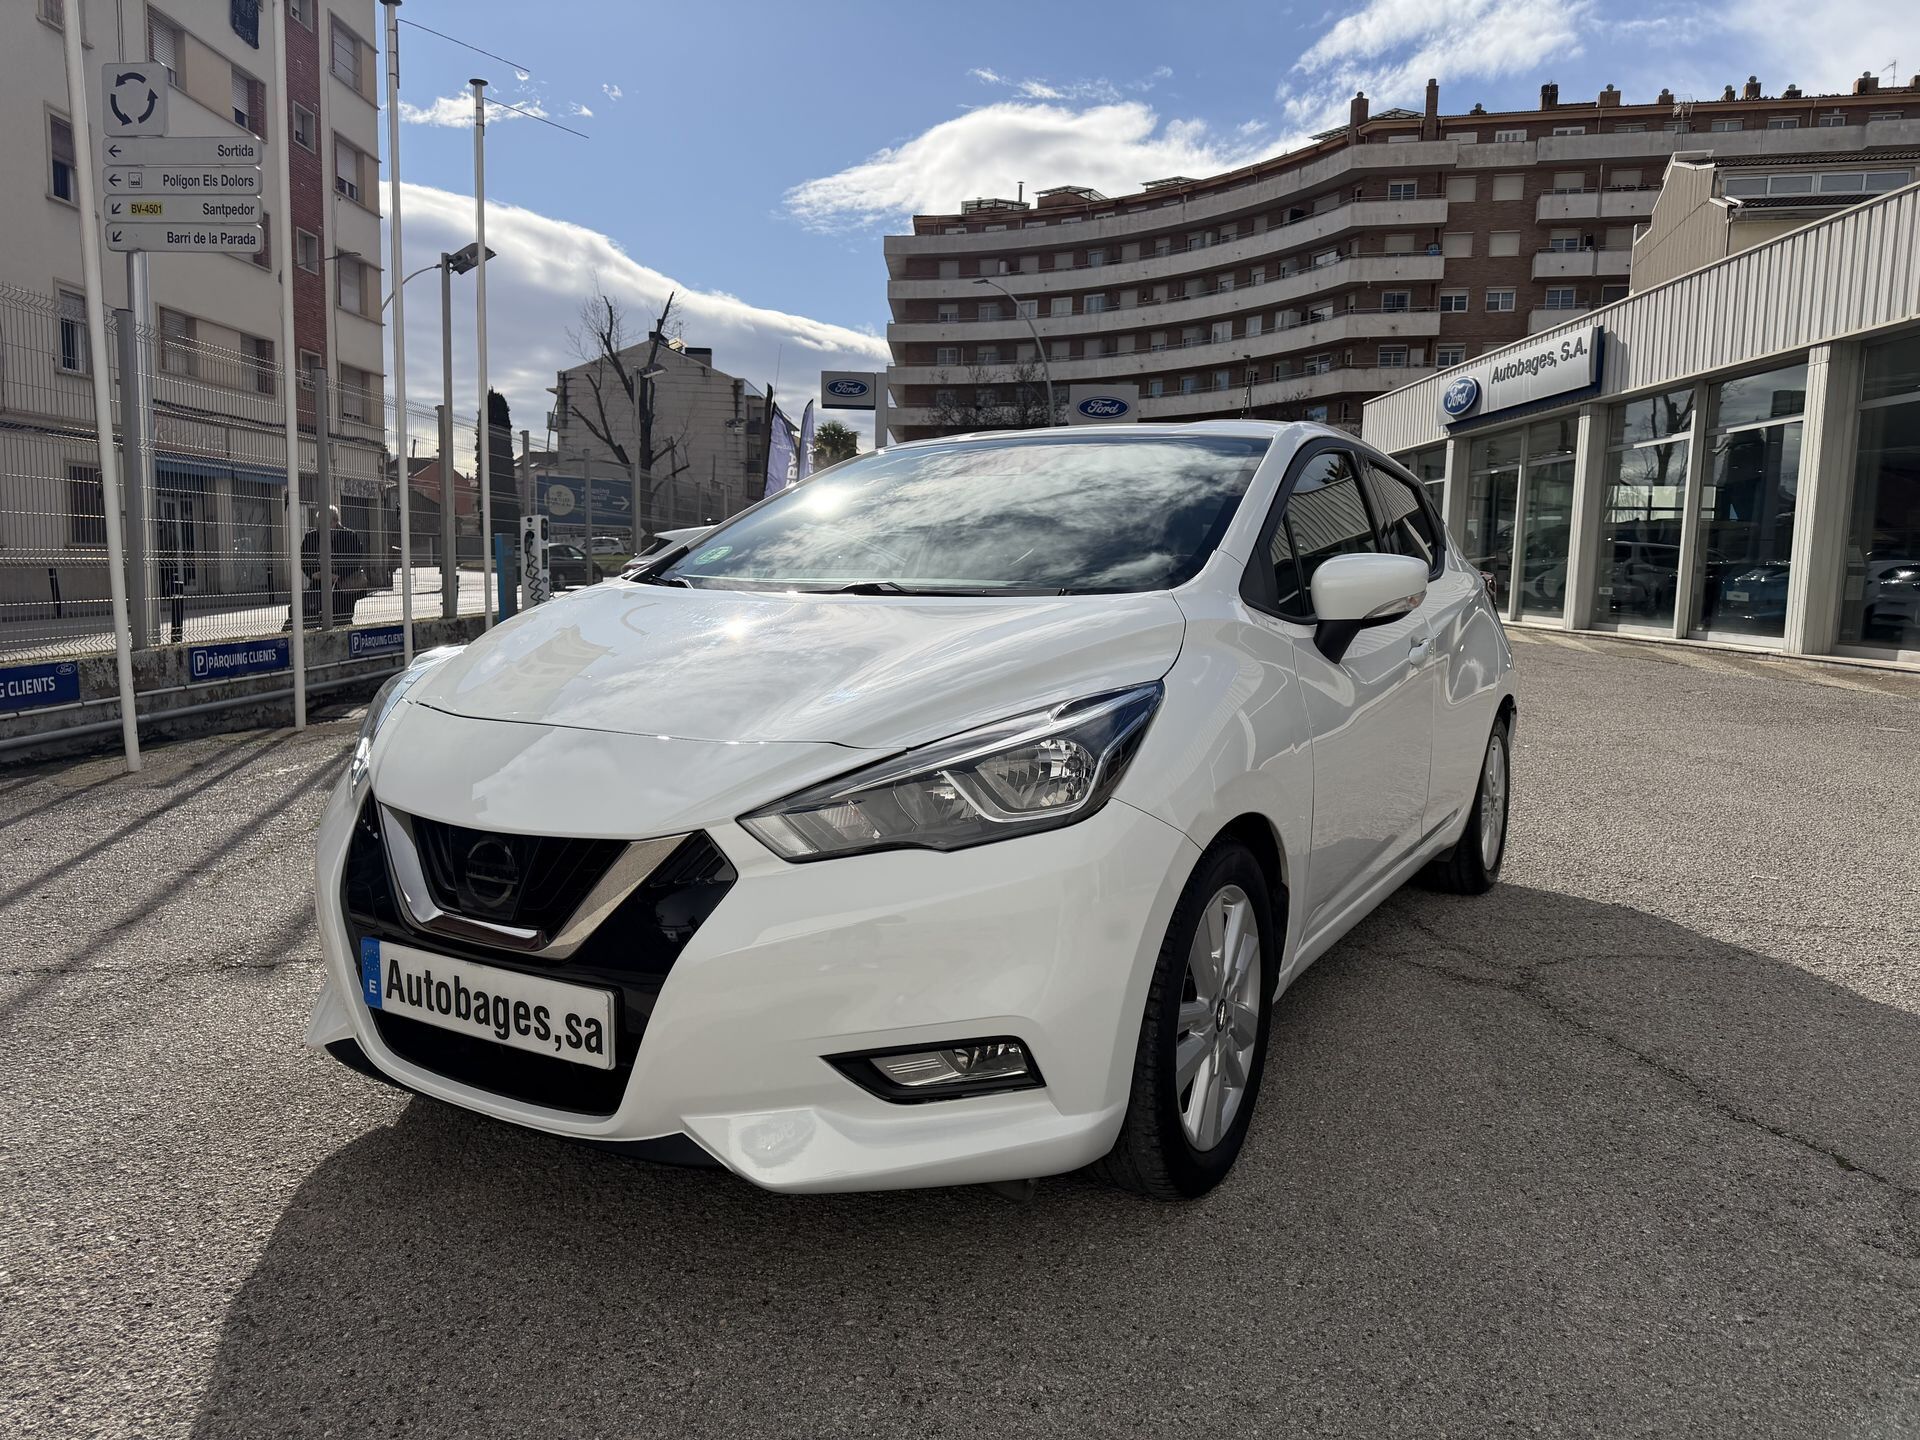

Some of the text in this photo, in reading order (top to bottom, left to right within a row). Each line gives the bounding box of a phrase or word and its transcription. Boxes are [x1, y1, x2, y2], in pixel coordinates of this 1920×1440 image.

[217, 144, 254, 157] Sortida
[162, 174, 254, 189] Polígon Els Dolors
[131, 202, 254, 218] BV-4501 Santpedor
[166, 231, 256, 245] Barri de la Parada
[1490, 336, 1588, 385] Autobages, S.A.
[833, 381, 862, 395] Ford
[1446, 382, 1474, 409] Ford
[1086, 399, 1121, 415] Ford
[387, 632, 404, 644] CLIENT
[196, 655, 204, 671] P
[248, 648, 277, 664] CLIENTS
[8, 676, 56, 697] CLIENTS
[368, 979, 377, 994] E
[385, 959, 604, 1055] Autobages,sa
